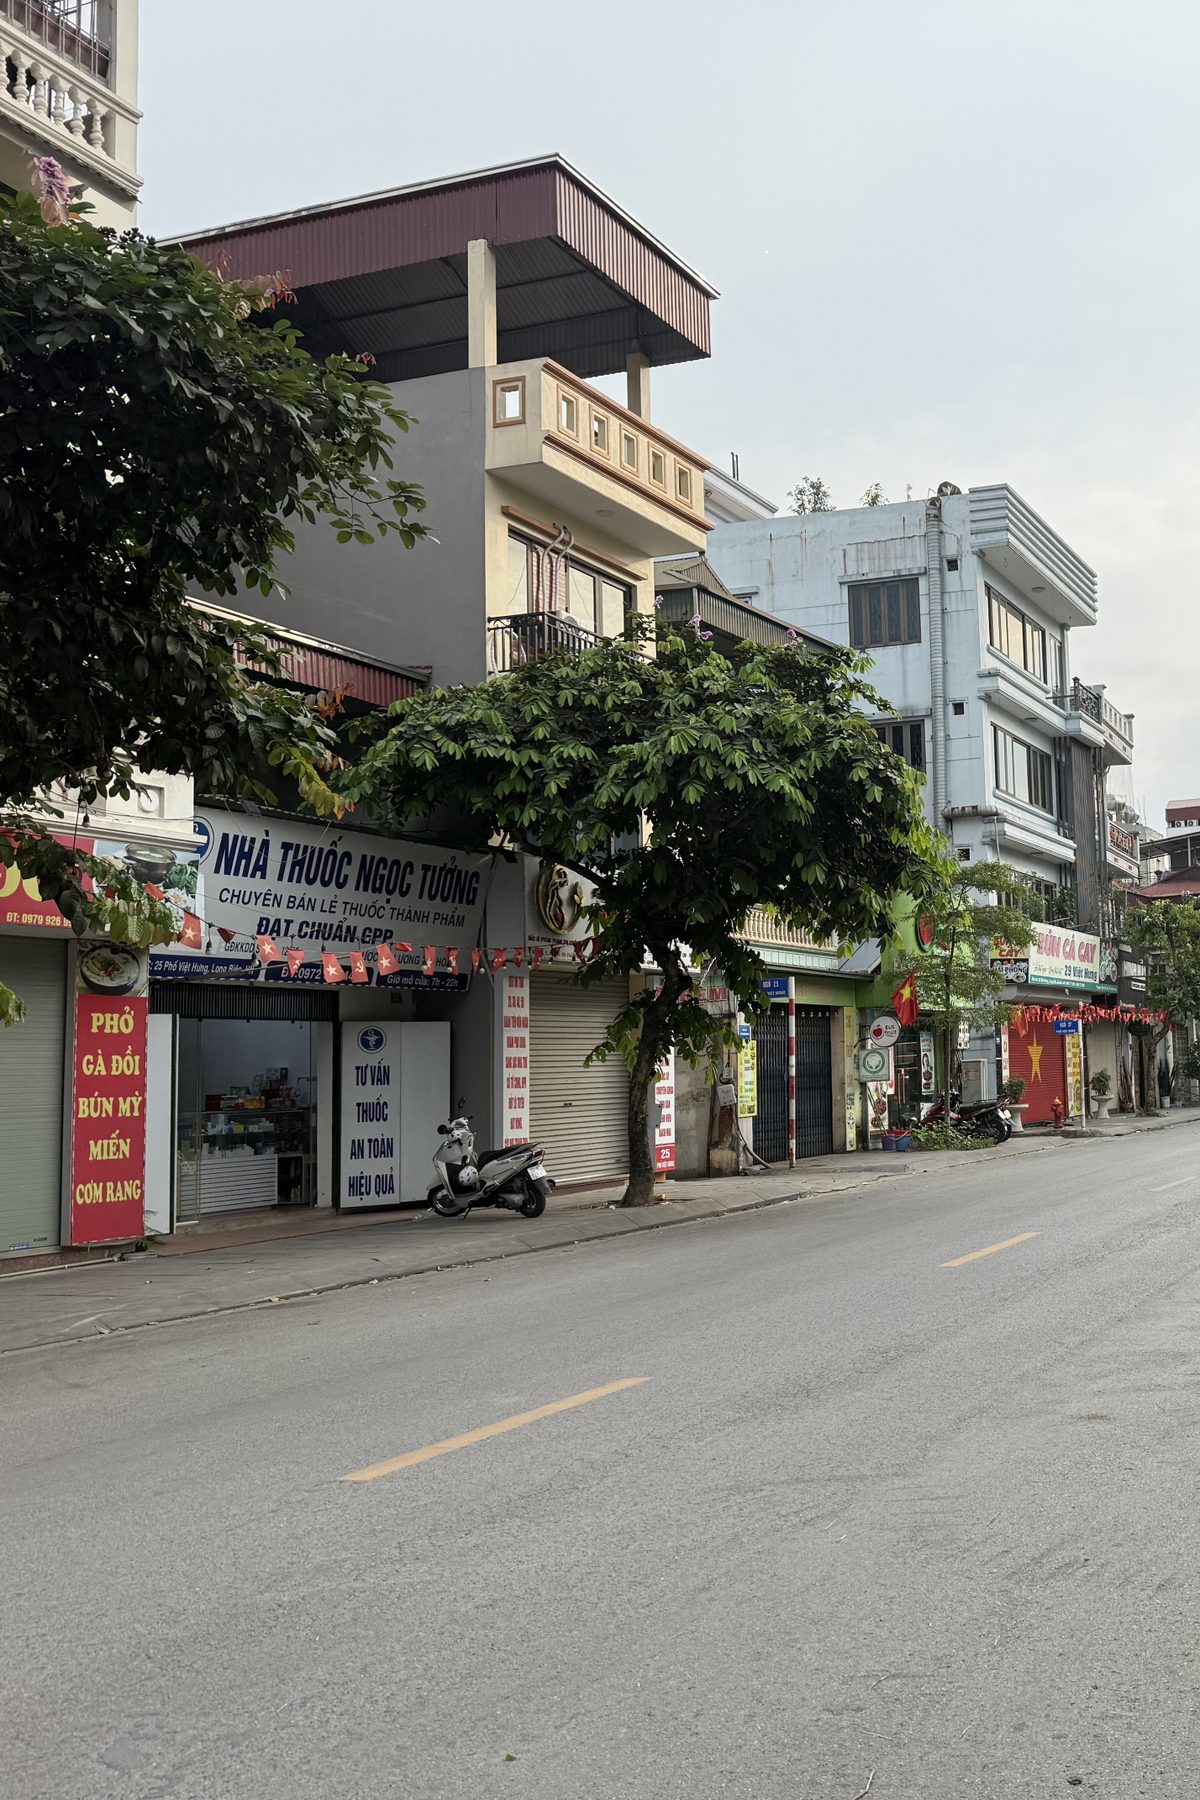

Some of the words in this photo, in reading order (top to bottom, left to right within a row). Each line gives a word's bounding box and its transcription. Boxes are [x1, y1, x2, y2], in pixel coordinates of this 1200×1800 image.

[214, 830, 270, 879] NHÀ
[277, 835, 352, 889] THUỐC
[354, 853, 414, 904] NGỌC
[418, 855, 480, 906] TƯỞNG
[22, 914, 43, 924] 0979
[45, 916, 60, 926] 926
[219, 888, 283, 908] CHUYÊN
[286, 893, 317, 911] BÁN
[320, 894, 338, 914] LẺ
[342, 899, 386, 919] THUỐC
[389, 905, 430, 924] THÀNH
[432, 906, 466, 928] PHẨM
[298, 917, 357, 943] CHUẨN
[361, 926, 394, 945] GPP
[1037, 929, 1061, 958] BÚN
[1062, 933, 1076, 960] CÁ
[1078, 941, 1097, 963] CAY
[154, 960, 163, 970] 25
[164, 959, 178, 971] Phố
[179, 960, 191, 973] Việt
[192, 962, 209, 975] Hưng,
[387, 974, 400, 984] Giờ
[401, 975, 414, 985] mở
[415, 975, 430, 986] cửa:
[431, 977, 440, 986] 7h
[445, 978, 459, 987] 22h
[1064, 964, 1072, 976] 29
[91, 1006, 134, 1034] PHỞ
[82, 1049, 107, 1075] GÀ
[111, 1045, 140, 1075] ĐỒI
[355, 1063, 368, 1086] TƯ
[370, 1058, 390, 1086] VẤN
[78, 1092, 113, 1118] BÚN
[118, 1091, 142, 1117] MỲ
[356, 1094, 388, 1123] THUỐC
[89, 1130, 131, 1161] MIẾN
[350, 1138, 364, 1160] AN
[367, 1133, 394, 1159] TOÀN
[661, 1148, 670, 1160] 25
[76, 1180, 103, 1204] CƠM
[106, 1180, 141, 1202] RANG
[348, 1171, 371, 1201] HIỆU
[374, 1166, 395, 1198] QUẢ
